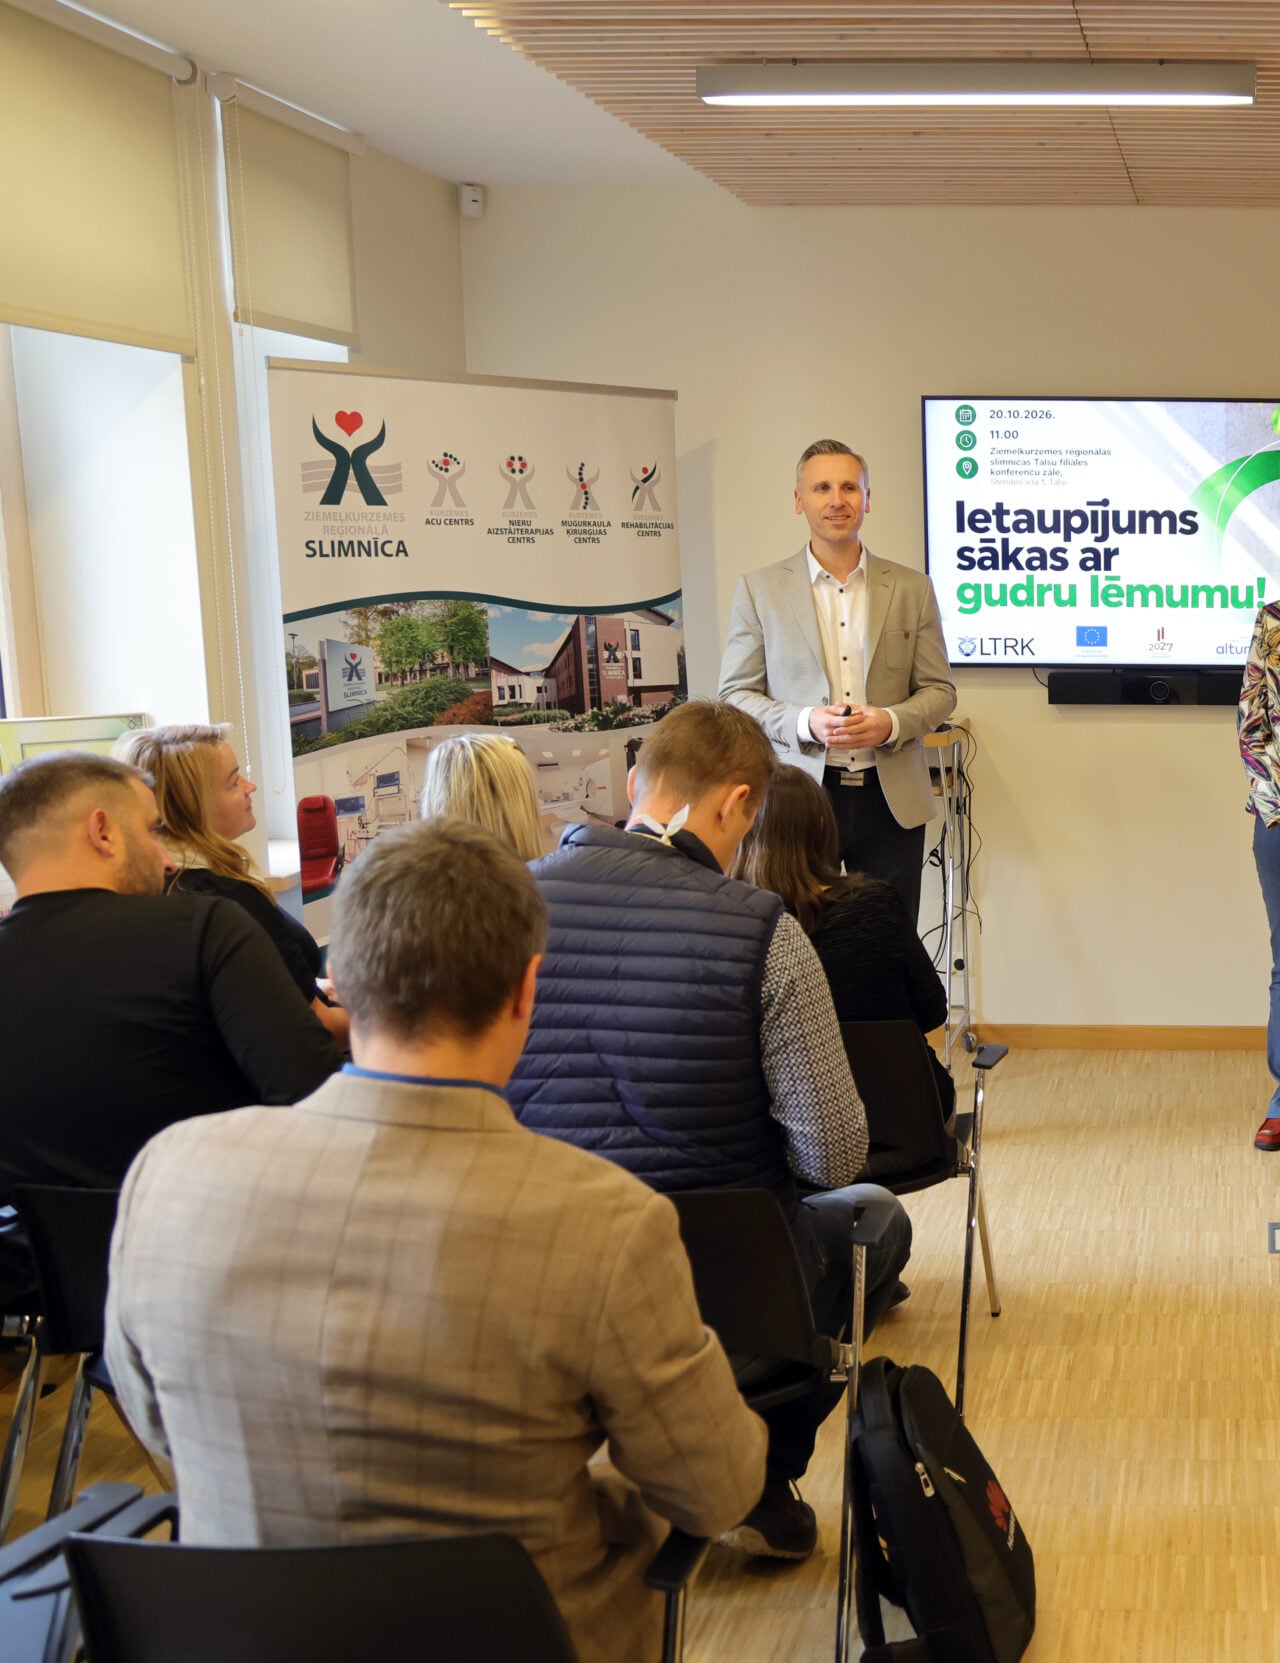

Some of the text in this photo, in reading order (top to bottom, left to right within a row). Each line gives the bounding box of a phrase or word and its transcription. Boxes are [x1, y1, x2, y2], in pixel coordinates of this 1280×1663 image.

[989, 409, 1056, 419] 20.10.2026.
[990, 430, 1019, 439] 11.00
[304, 511, 406, 525] ZIEMEĻKURZEMES
[425, 518, 475, 526] ACU CENTRS
[509, 519, 532, 527] NIERU
[956, 498, 1199, 542] Ietaupījums
[561, 519, 612, 528] MUGURKAULA
[621, 521, 675, 530] REHABILITĀCIJAS
[322, 523, 389, 538] REĢIONĀLĀ
[486, 526, 554, 536] AIZSTĀJTERAPIJAS
[507, 536, 536, 544] CENTRS
[573, 536, 601, 544] CENTRS
[305, 538, 409, 558] SLIMNĪCA
[956, 537, 1119, 571] sākas ar
[956, 574, 1266, 614] gudru lēmumu!
[980, 637, 1036, 656] LTRK
[1148, 641, 1174, 652] 2027
